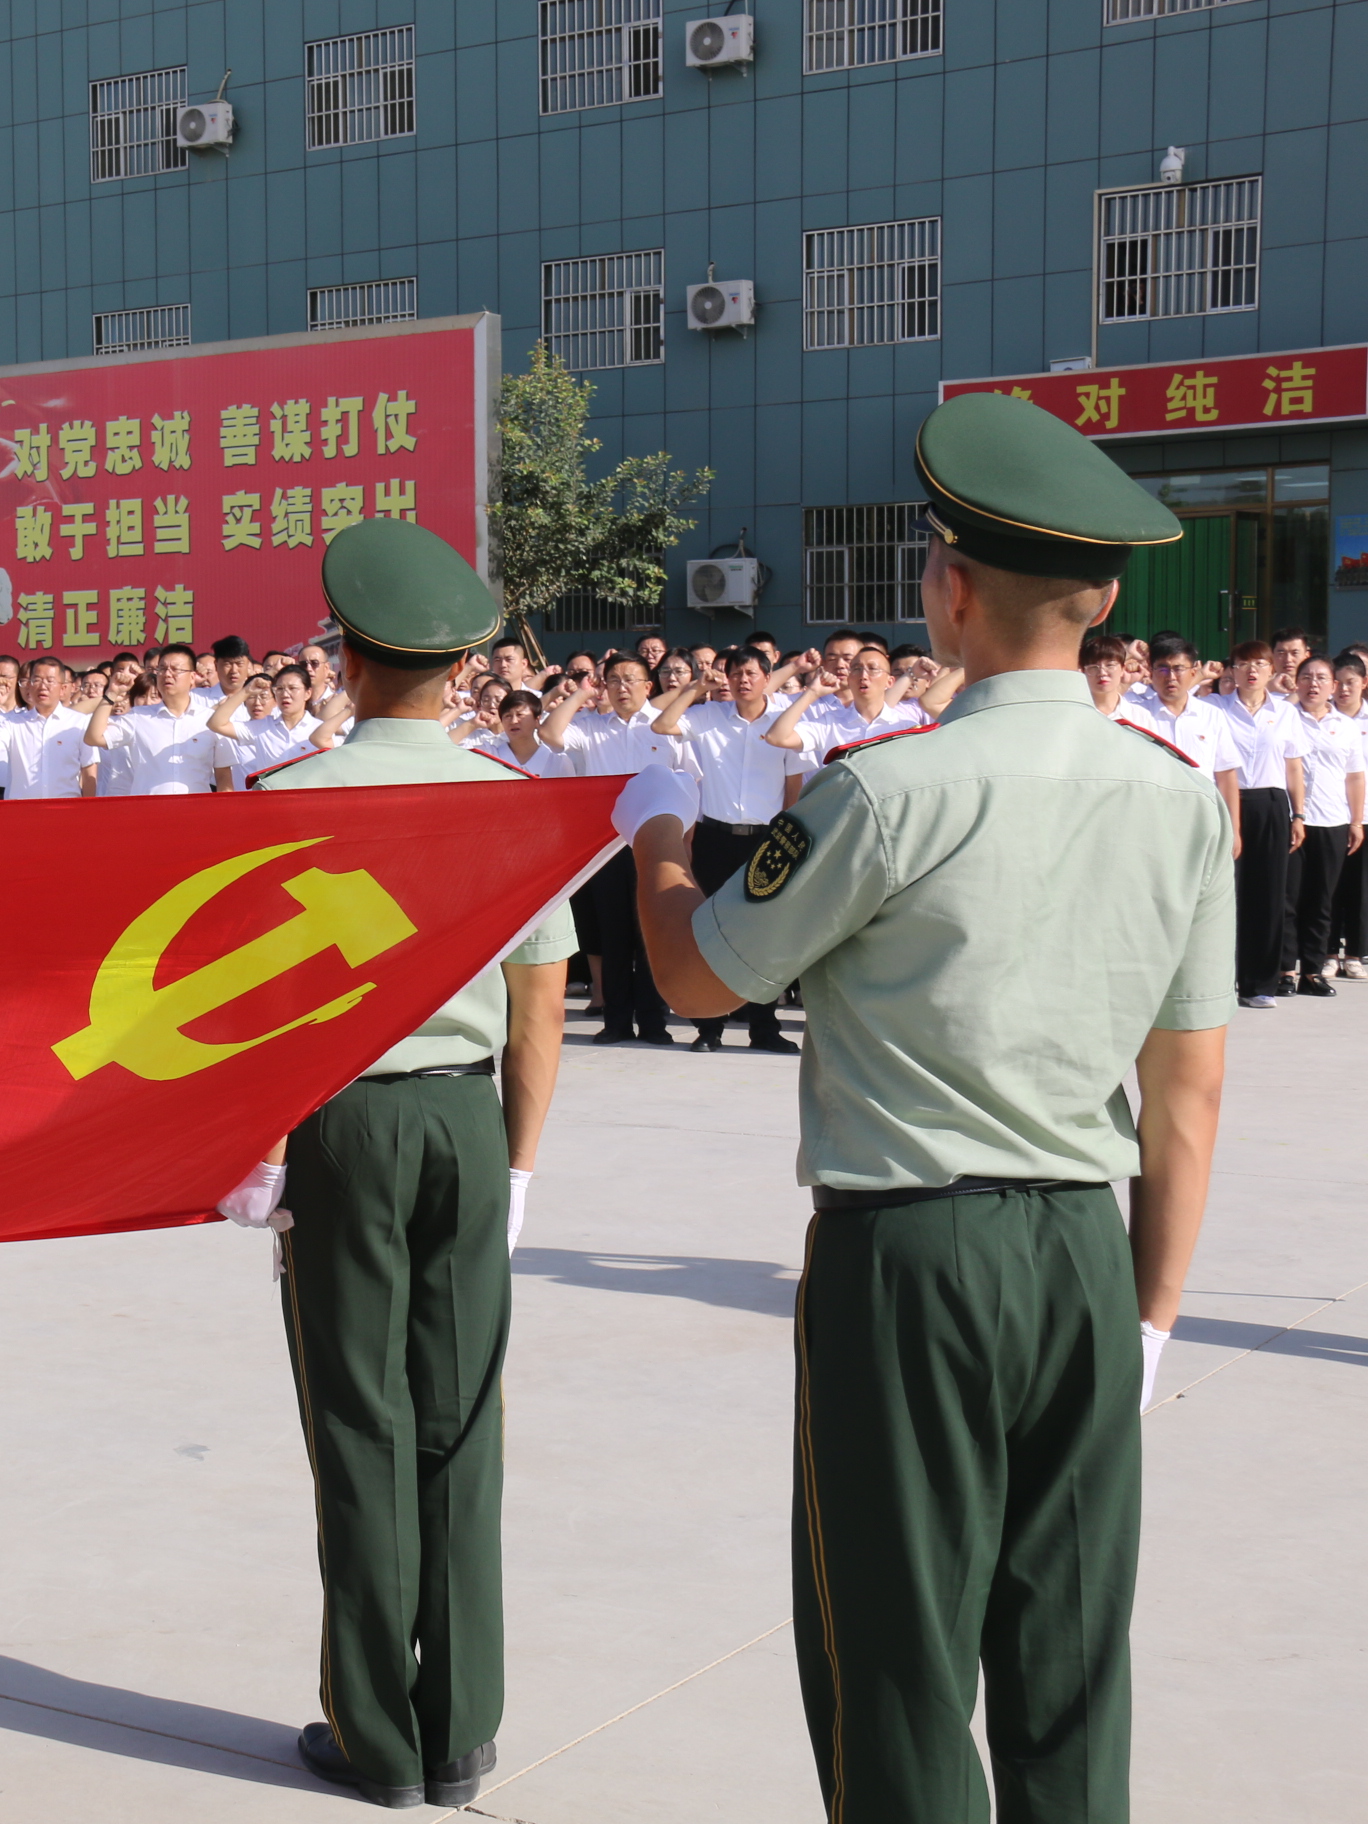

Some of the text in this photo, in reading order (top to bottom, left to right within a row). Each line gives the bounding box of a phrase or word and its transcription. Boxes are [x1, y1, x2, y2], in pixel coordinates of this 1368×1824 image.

[14, 390, 418, 482] 对党忠诚 善谋打仗
[16, 495, 190, 563] 敢于担当
[17, 583, 194, 650] 清正廉洁
